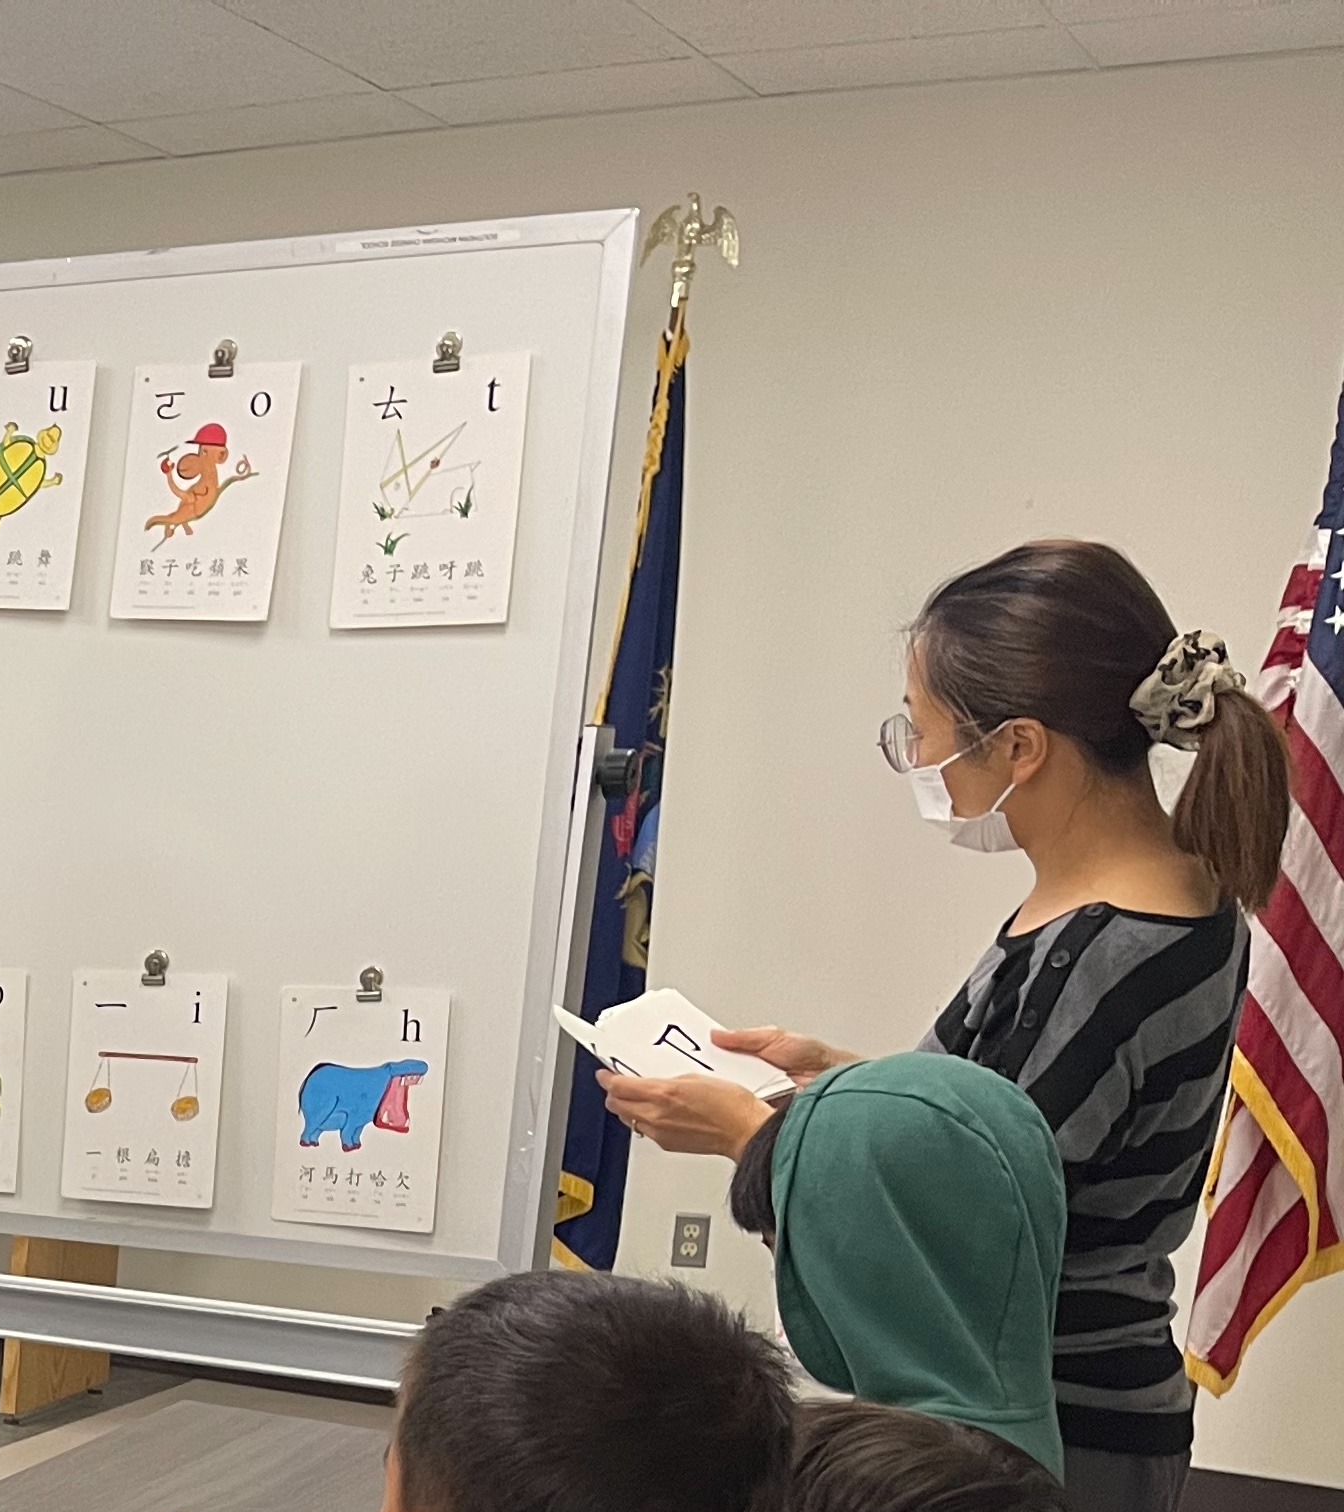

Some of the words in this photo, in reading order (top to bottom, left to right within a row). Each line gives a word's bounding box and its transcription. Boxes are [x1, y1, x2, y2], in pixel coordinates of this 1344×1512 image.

[49, 385, 68, 412] u
[487, 376, 501, 412] t
[192, 991, 201, 1024] i
[400, 1009, 422, 1042] h
